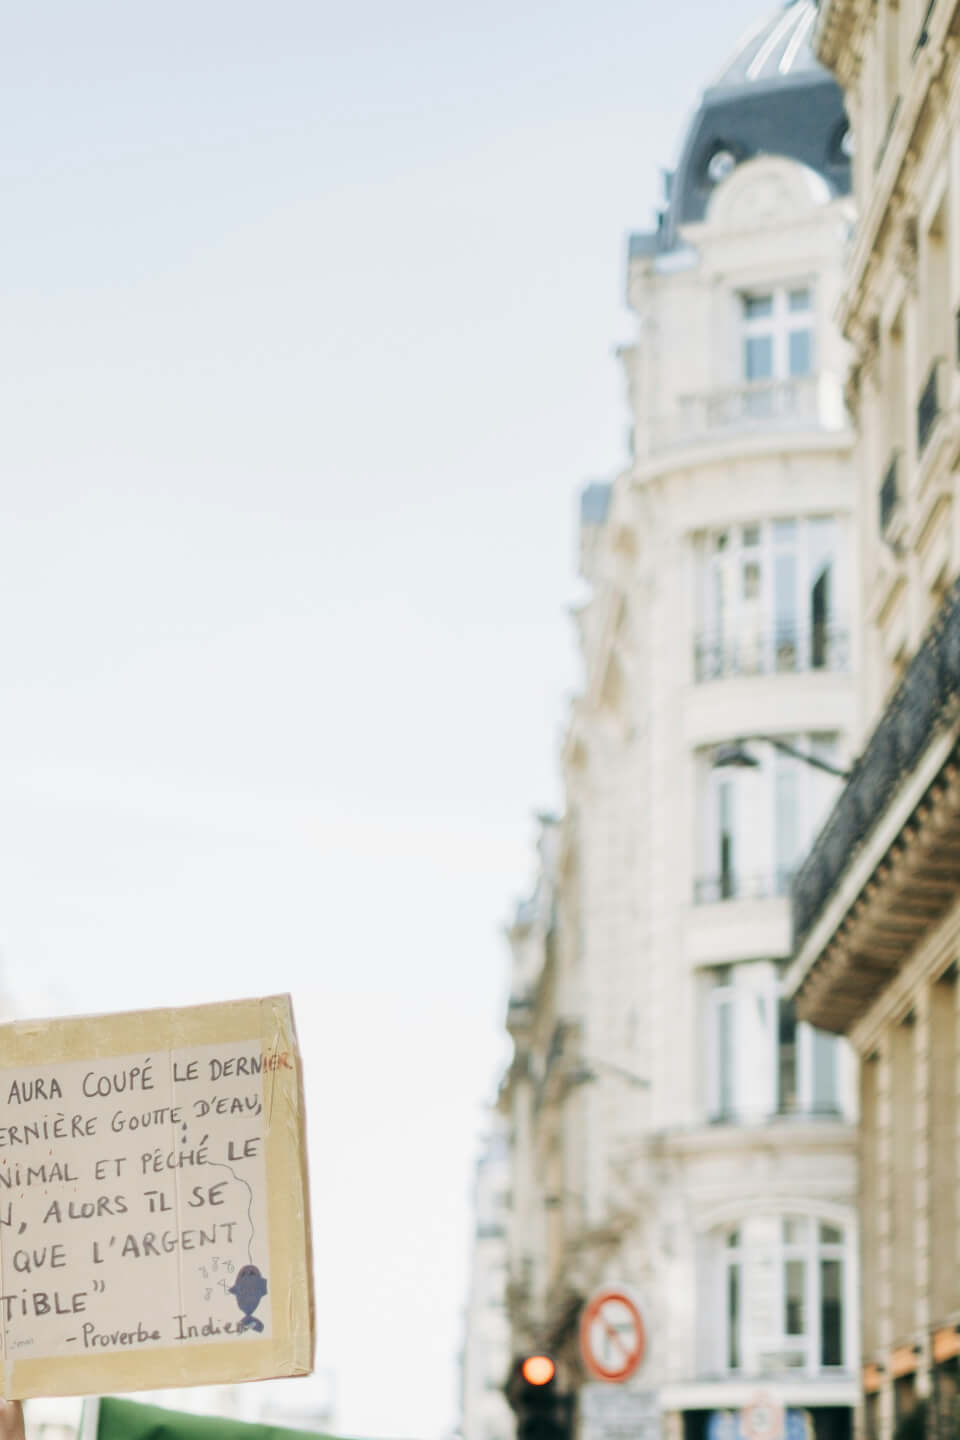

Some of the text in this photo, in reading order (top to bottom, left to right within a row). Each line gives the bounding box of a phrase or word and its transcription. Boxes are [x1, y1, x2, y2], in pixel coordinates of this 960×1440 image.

[7, 1078, 63, 1105] AURA
[82, 1057, 155, 1098] COUPÉ
[173, 1061, 199, 1083] LE
[111, 1106, 182, 1133] GOUTTE
[194, 1093, 263, 1119] D'EAU,
[95, 1157, 127, 1180] ET
[227, 1137, 261, 1161] LE
[43, 1195, 128, 1224] ALORS
[144, 1190, 172, 1213] IL
[187, 1181, 228, 1207] SE
[12, 1243, 67, 1274] QUE
[92, 1221, 238, 1264] L'ARGENT
